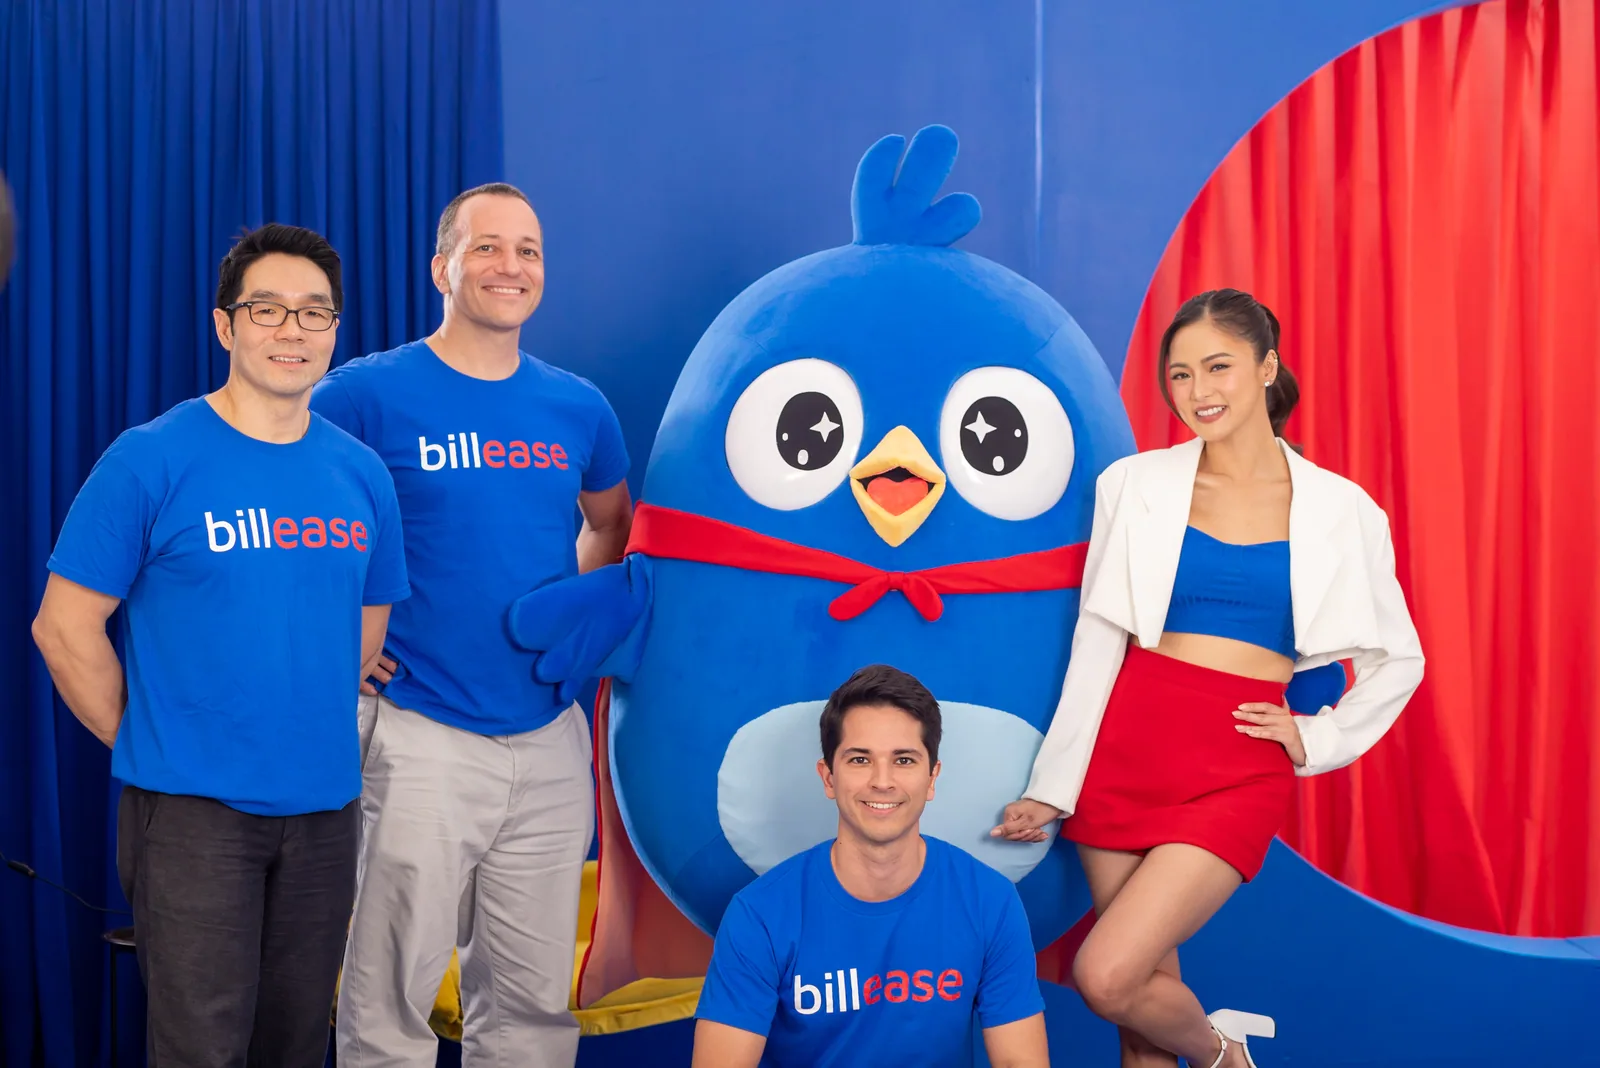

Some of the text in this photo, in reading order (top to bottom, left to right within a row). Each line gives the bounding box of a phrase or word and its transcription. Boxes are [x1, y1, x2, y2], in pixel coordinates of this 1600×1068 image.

[418, 432, 569, 471] billease
[204, 508, 368, 552] billease
[793, 968, 964, 1014] billease
